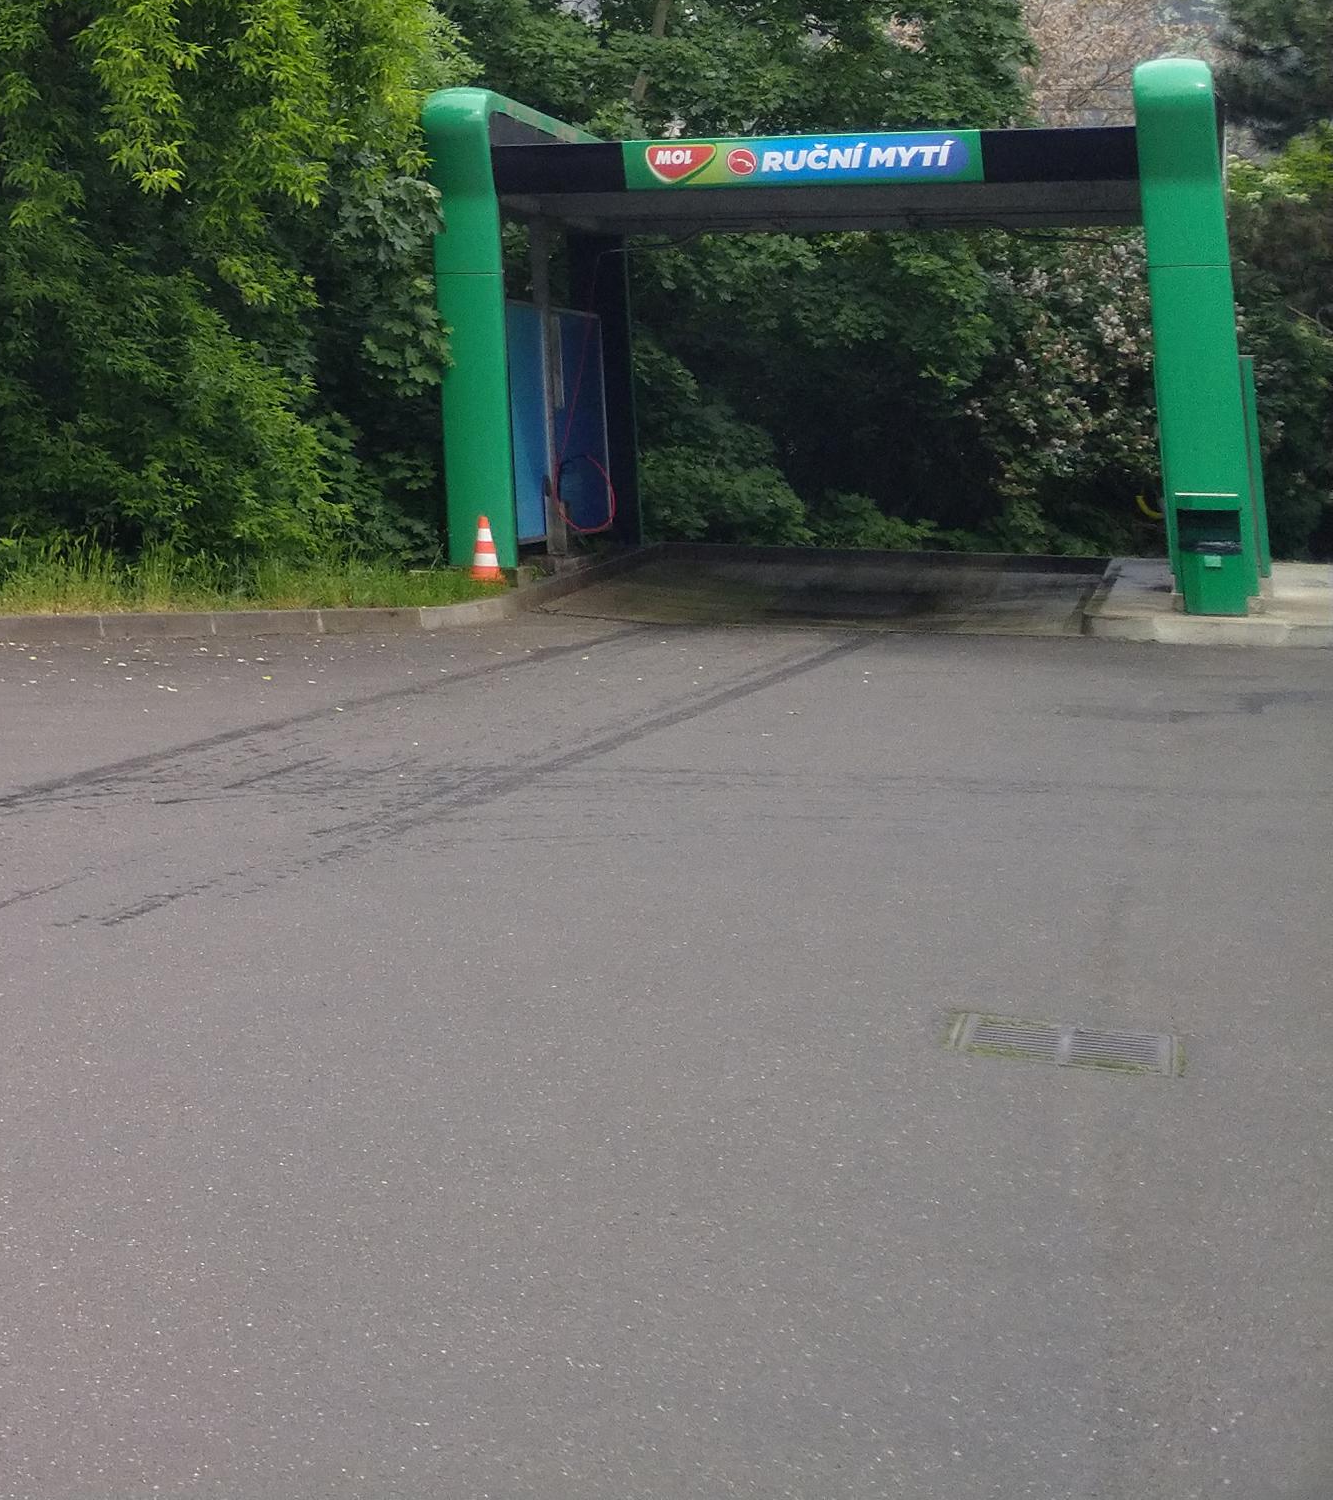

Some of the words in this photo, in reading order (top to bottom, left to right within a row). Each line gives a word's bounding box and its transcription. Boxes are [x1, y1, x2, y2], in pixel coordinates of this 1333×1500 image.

[655, 150, 692, 165] MOL
[761, 143, 866, 172] RUČNÍ
[868, 140, 957, 169] MYTÍ
